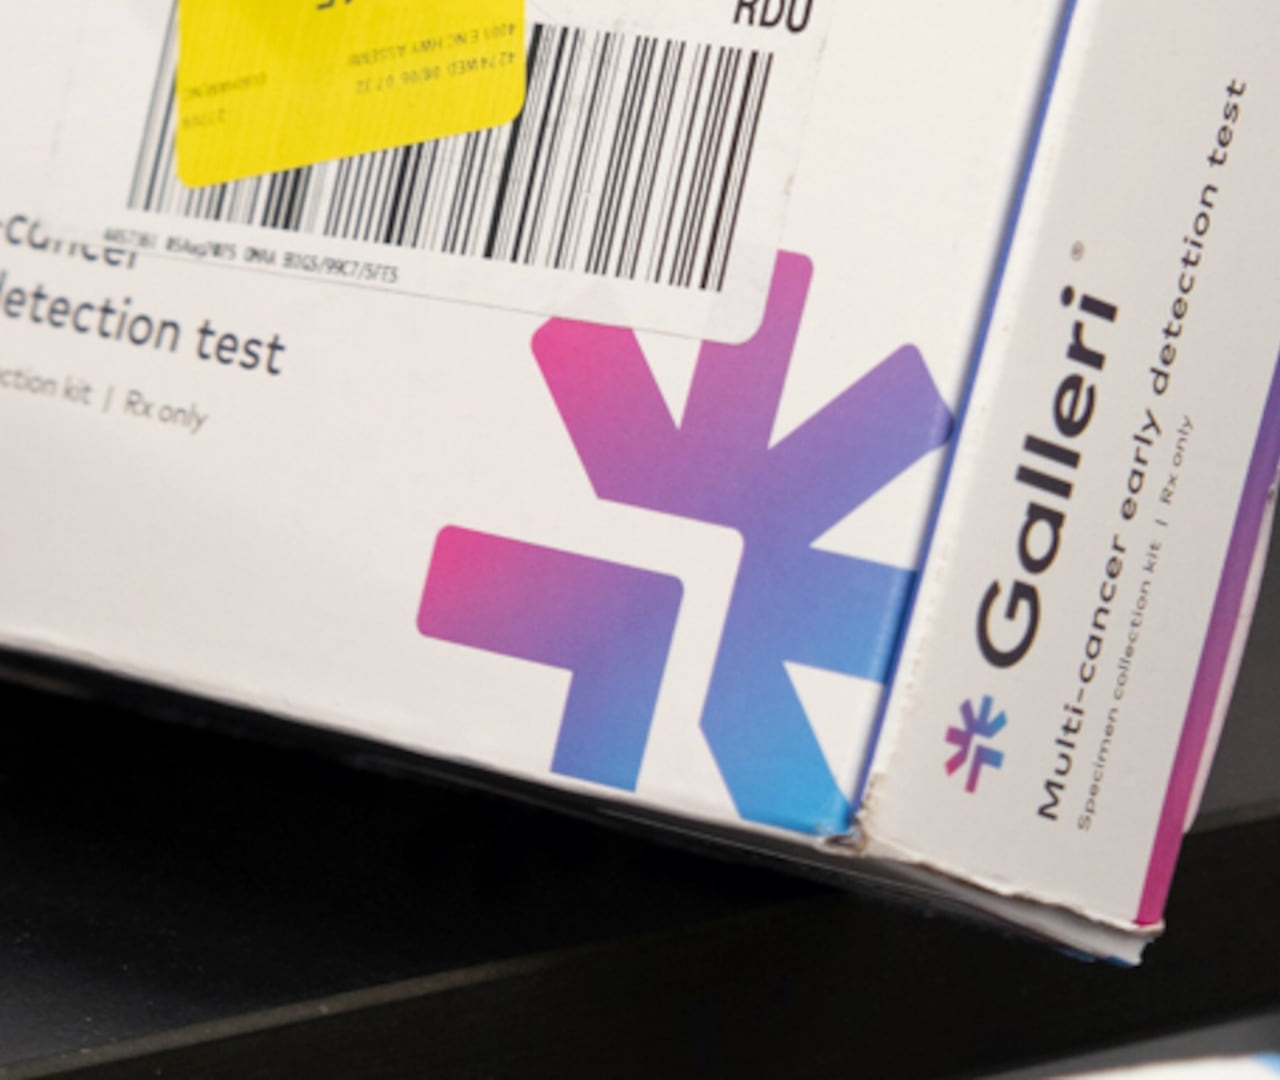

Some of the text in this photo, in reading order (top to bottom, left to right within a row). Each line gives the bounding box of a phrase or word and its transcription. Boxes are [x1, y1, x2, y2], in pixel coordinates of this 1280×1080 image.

[63, 376, 92, 406] kit
[124, 390, 154, 420] Rx
[158, 399, 208, 433] only
[196, 319, 287, 376] test
[977, 284, 1118, 669] Galleri
[1038, 79, 1247, 822] Multi-cancer early detection test
[1079, 706, 1120, 832] Specimen
[1112, 576, 1151, 700] collection
[1144, 537, 1163, 573] kit
[1160, 472, 1178, 506] Rx
[1172, 414, 1194, 466] only
